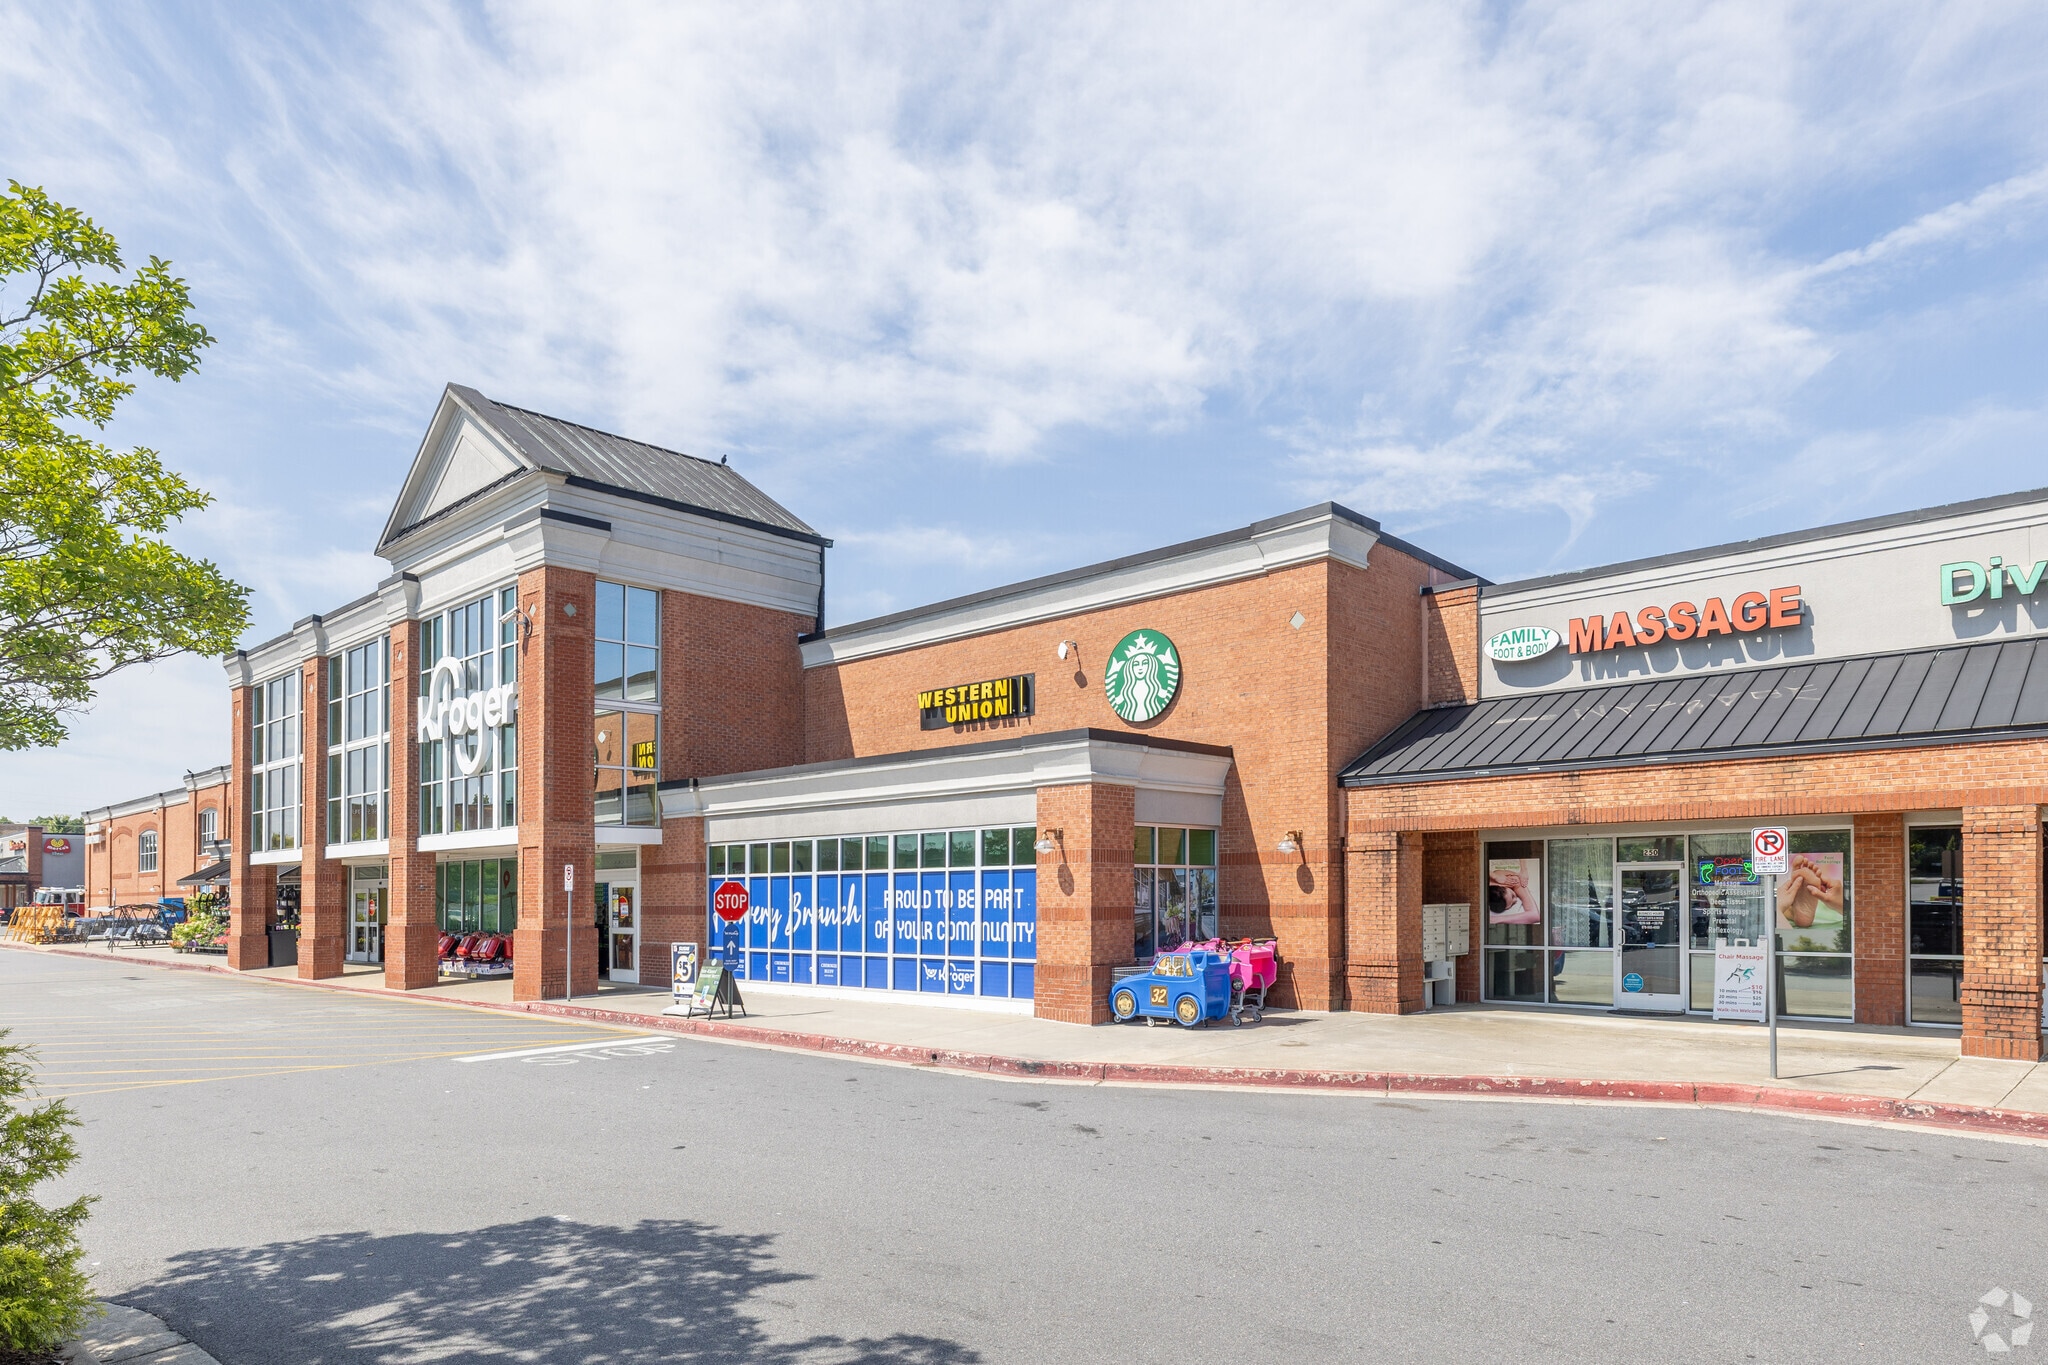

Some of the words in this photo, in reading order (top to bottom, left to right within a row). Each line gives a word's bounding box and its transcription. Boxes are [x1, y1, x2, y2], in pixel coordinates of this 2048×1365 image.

[1941, 556, 2048, 606] Div
[1569, 585, 1801, 655] MASSAGE
[1491, 627, 1551, 648] FAMILY
[1493, 647, 1516, 659] FOOT
[1516, 646, 1524, 657] &
[1525, 642, 1549, 656] BODY
[917, 679, 1008, 709] WESTERN
[418, 656, 518, 775] Kroger
[945, 698, 1008, 723] UNION
[1643, 849, 1659, 857] 250
[1714, 857, 1744, 866] Open
[1715, 867, 1743, 875] FOOT
[1714, 880, 1741, 888] Massage
[1725, 888, 1762, 896] Assessment
[716, 893, 748, 909] STOP
[883, 889, 932, 909] PROUD
[935, 889, 954, 908] TO
[958, 889, 976, 909] BE
[984, 888, 1024, 910] PART
[785, 883, 862, 937] Branch
[1702, 908, 1722, 916] Sports
[1723, 908, 1750, 917] Massage
[896, 919, 933, 941] YOUR
[1708, 927, 1744, 935] Reflexology
[678, 961, 689, 976] $5
[938, 962, 976, 991] Kroger
[1151, 988, 1167, 1003] 32
